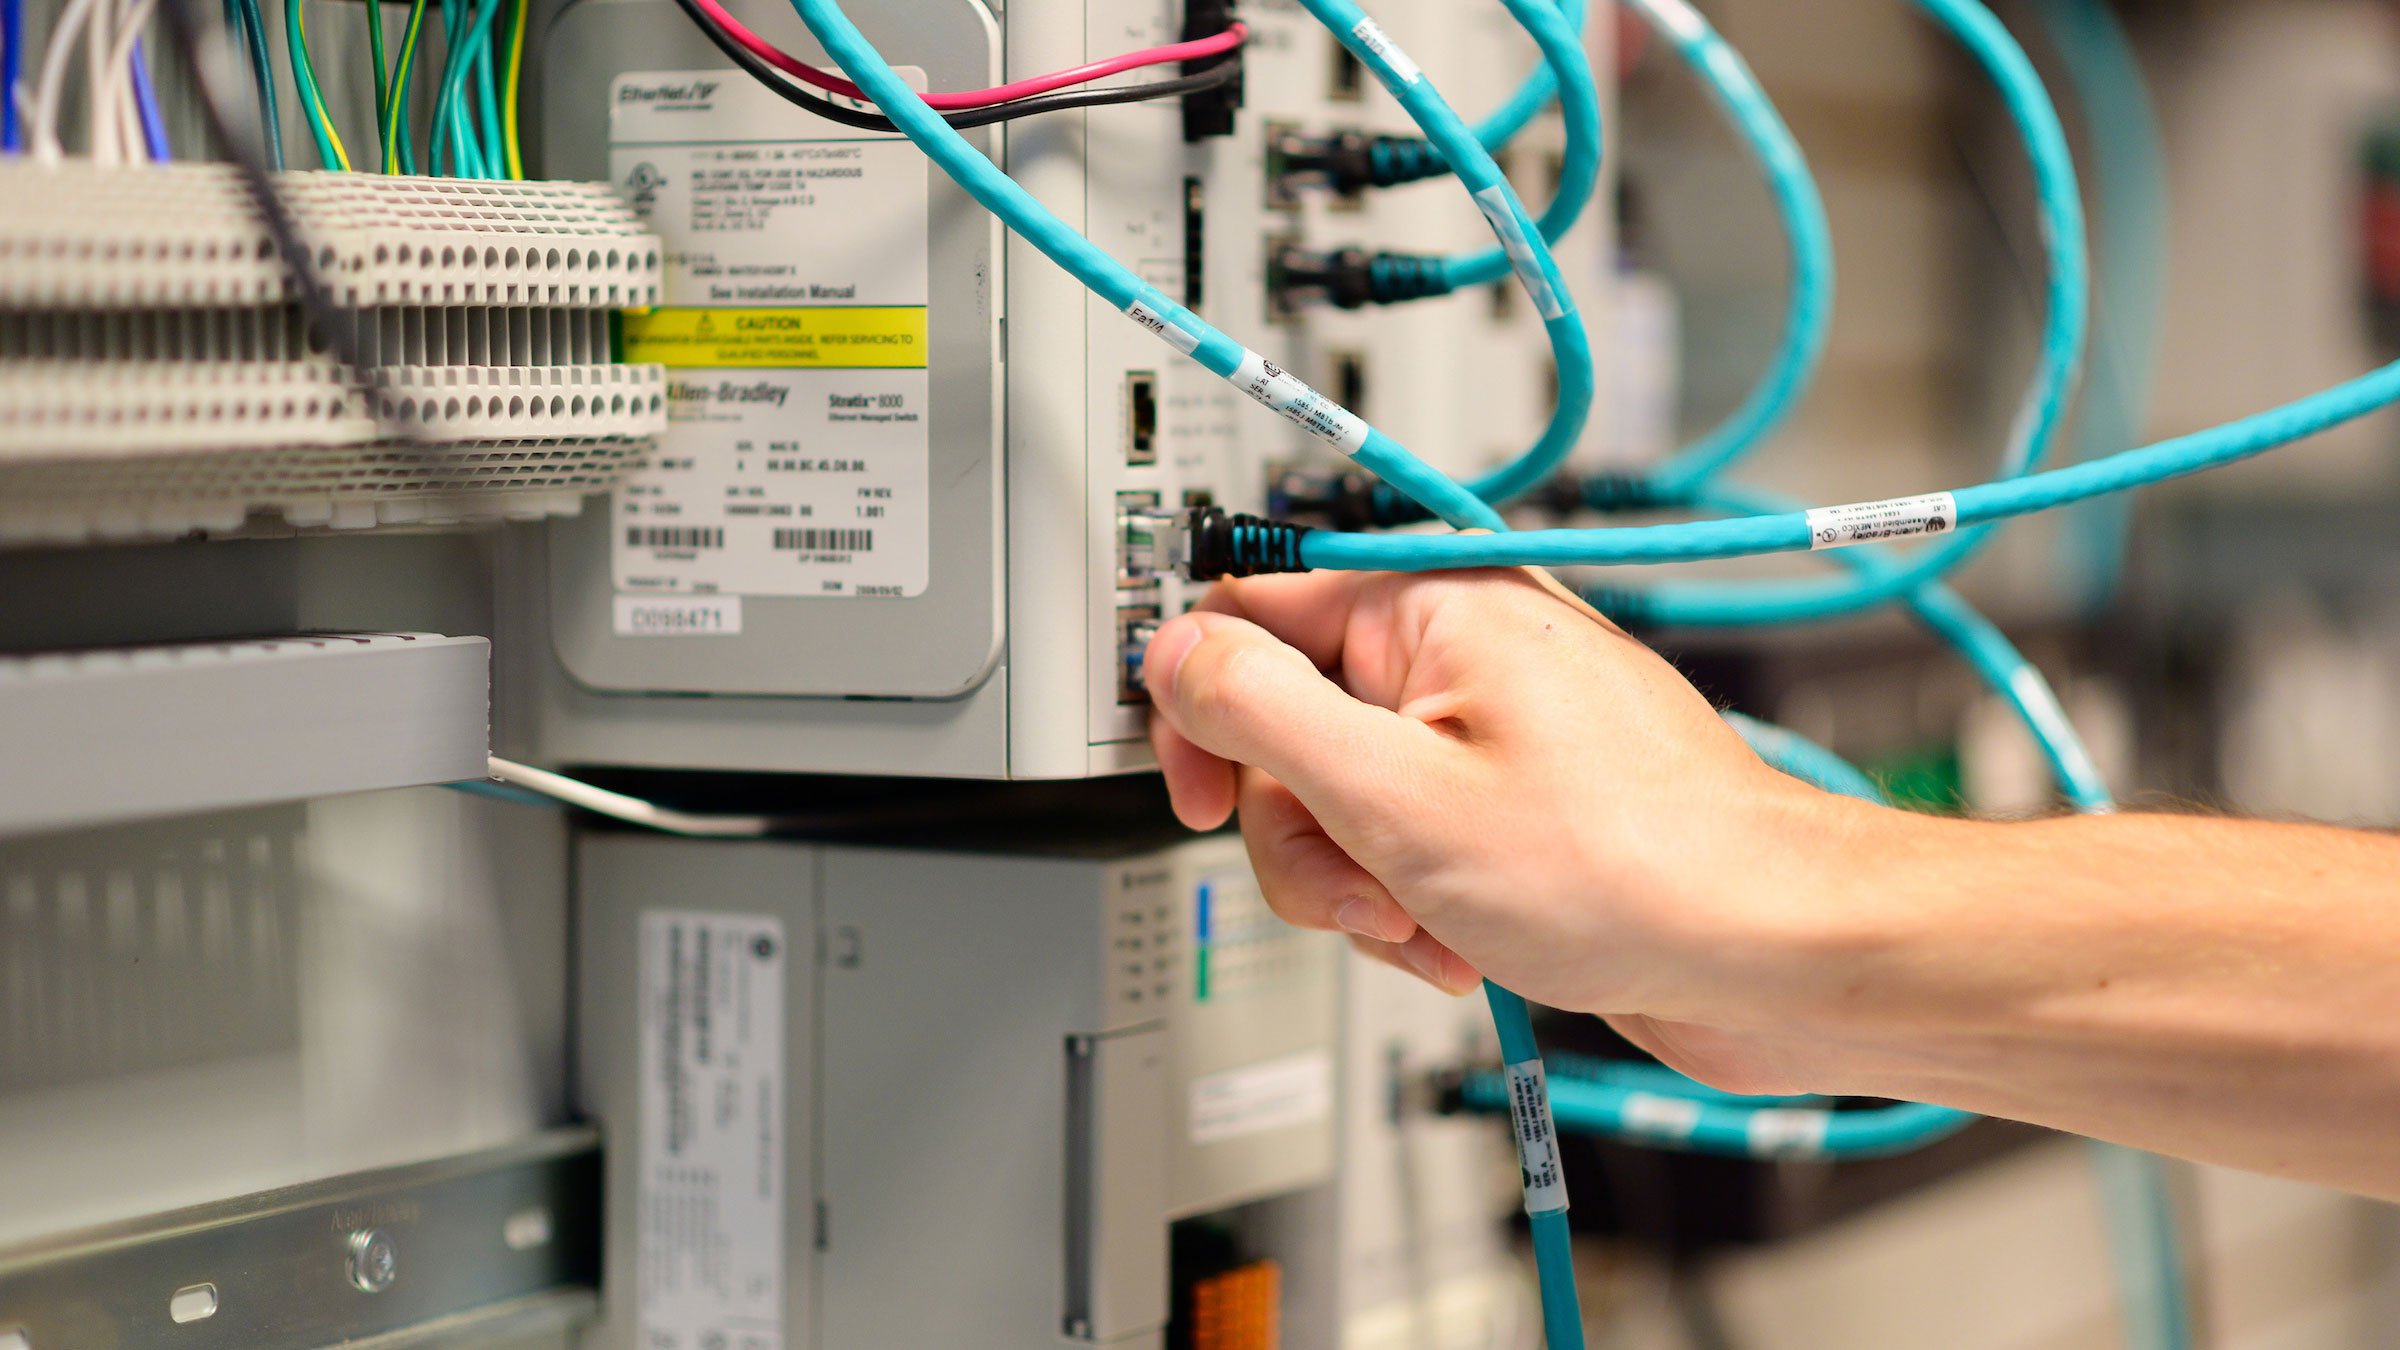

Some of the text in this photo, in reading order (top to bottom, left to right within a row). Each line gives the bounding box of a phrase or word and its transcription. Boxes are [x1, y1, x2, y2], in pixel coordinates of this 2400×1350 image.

[710, 283, 855, 299] See Installation Manual
[736, 317, 801, 330] CAUTION
[1130, 307, 1165, 334] Fa1/4
[850, 334, 897, 344] SERVICING
[900, 334, 913, 344] TO
[878, 393, 904, 408] 8000
[861, 413, 892, 423] Managed
[894, 413, 919, 421] Switch
[1842, 522, 1872, 532] MEXICO
[1883, 516, 1928, 529] Assembled
[1850, 527, 1924, 540] Allen-Bradley
